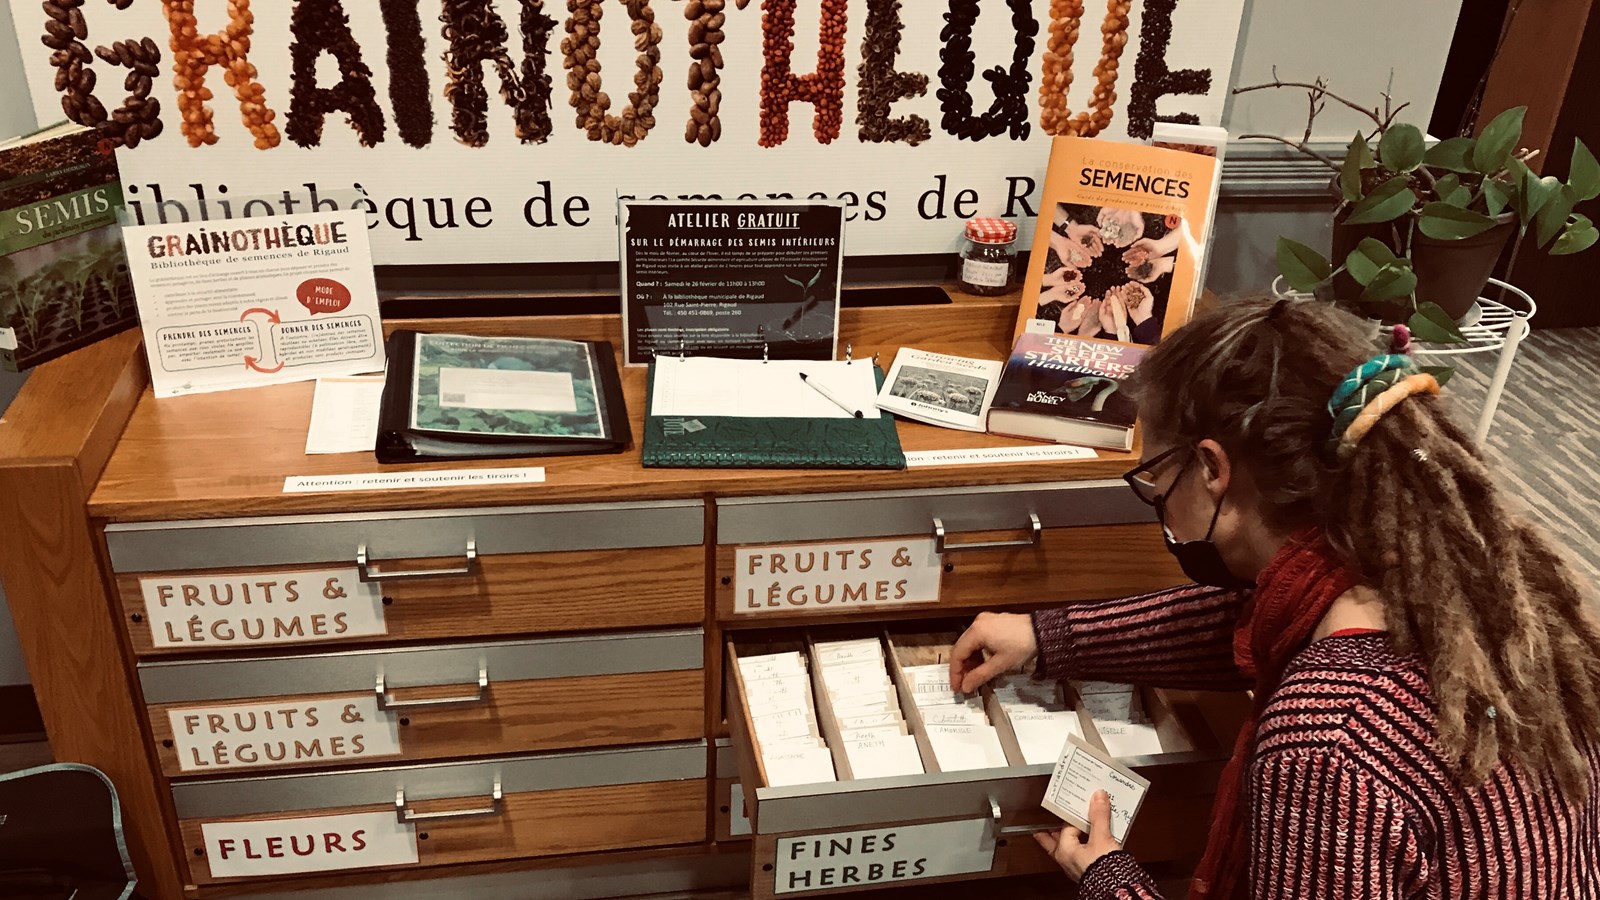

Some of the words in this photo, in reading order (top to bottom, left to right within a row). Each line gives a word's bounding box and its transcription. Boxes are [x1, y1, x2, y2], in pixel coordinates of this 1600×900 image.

[1082, 156, 1094, 166] La
[1099, 159, 1170, 176] conservation
[1174, 169, 1193, 180] des
[1079, 167, 1190, 199] SEMENCES
[918, 174, 979, 221] de
[1000, 175, 1038, 218] R
[15, 189, 109, 235] SEMIS
[128, 183, 453, 241] ibliothèque
[524, 180, 590, 228] de
[668, 213, 730, 228] ATELIER
[737, 213, 800, 229] GRATUIT
[1169, 217, 1177, 225] N
[630, 238, 649, 247] SUR
[653, 238, 664, 247] LE
[669, 236, 723, 247] DÉMARRAGE
[728, 237, 744, 247] DES
[748, 237, 777, 247] SEMIS
[781, 235, 836, 247] INTÉRIEURS
[150, 259, 221, 270] Bibliothèque
[225, 255, 239, 263] de
[241, 253, 293, 262] semences
[297, 249, 310, 257] de
[313, 246, 349, 256] Rigaud
[306, 295, 341, 307] D'EMPLOI
[315, 285, 334, 295] MODE
[163, 331, 195, 341] PRENDRE
[198, 329, 212, 338] DES
[214, 326, 252, 336] SEMENCES
[281, 325, 309, 334] DONNER
[312, 323, 324, 331] DES
[326, 319, 362, 330] SEMENCES
[1046, 336, 1079, 347] THE
[1079, 341, 1125, 353] NEW
[1050, 345, 1118, 361] SEED-
[1024, 350, 1136, 374] STARTERS
[1028, 359, 1130, 380] Handbook
[1028, 393, 1066, 402] NANCY
[296, 479, 352, 488] Attention
[361, 476, 401, 485] retenir
[419, 474, 465, 483] soutenir
[468, 472, 484, 481] les
[487, 471, 520, 480] tiroirs
[748, 548, 872, 576] FRUITS
[891, 546, 913, 568] &
[157, 579, 299, 608] FRUITS
[322, 577, 348, 600] &
[748, 579, 908, 609] LÉGUMES
[165, 611, 349, 643] LÉGUMES
[184, 706, 319, 736] FRUITS
[340, 704, 365, 724] &
[191, 734, 366, 767] LÉGUMES
[218, 829, 367, 860] FLEURS
[790, 832, 897, 861] FINES
[788, 857, 928, 889] HERBES
